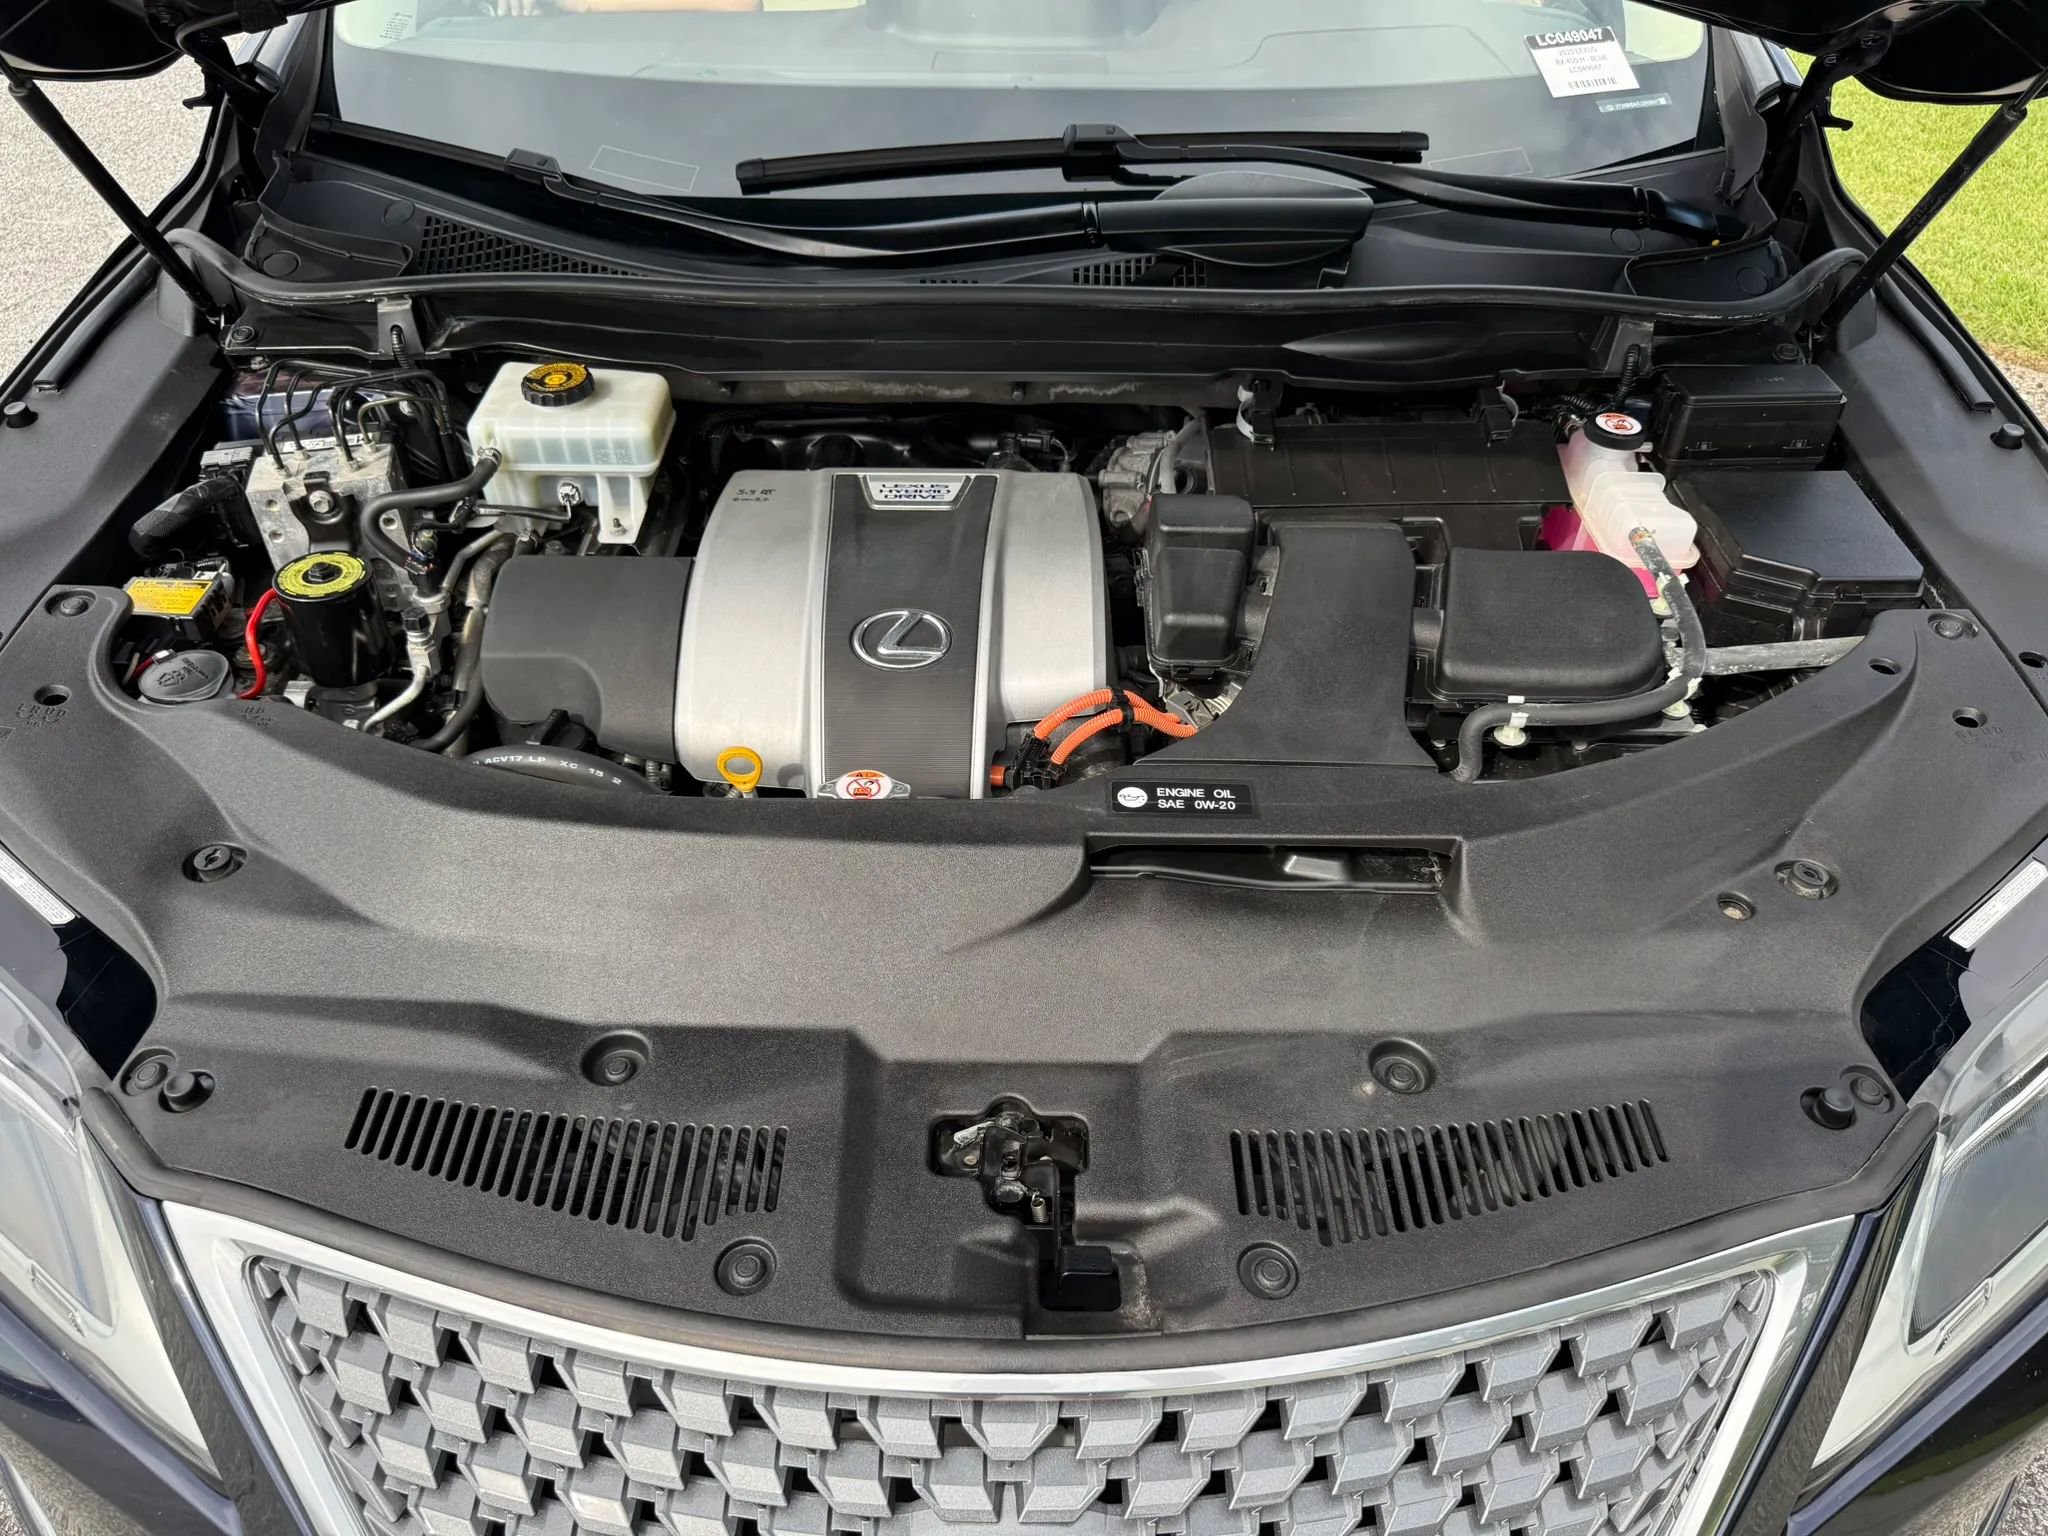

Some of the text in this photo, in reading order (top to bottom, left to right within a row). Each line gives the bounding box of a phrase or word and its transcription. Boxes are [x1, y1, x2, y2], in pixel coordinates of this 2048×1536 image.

[1535, 28, 1603, 47] LC049047
[1156, 787, 1236, 799] ENGINE OIL
[1157, 799, 1236, 810] SAE 0W-20
